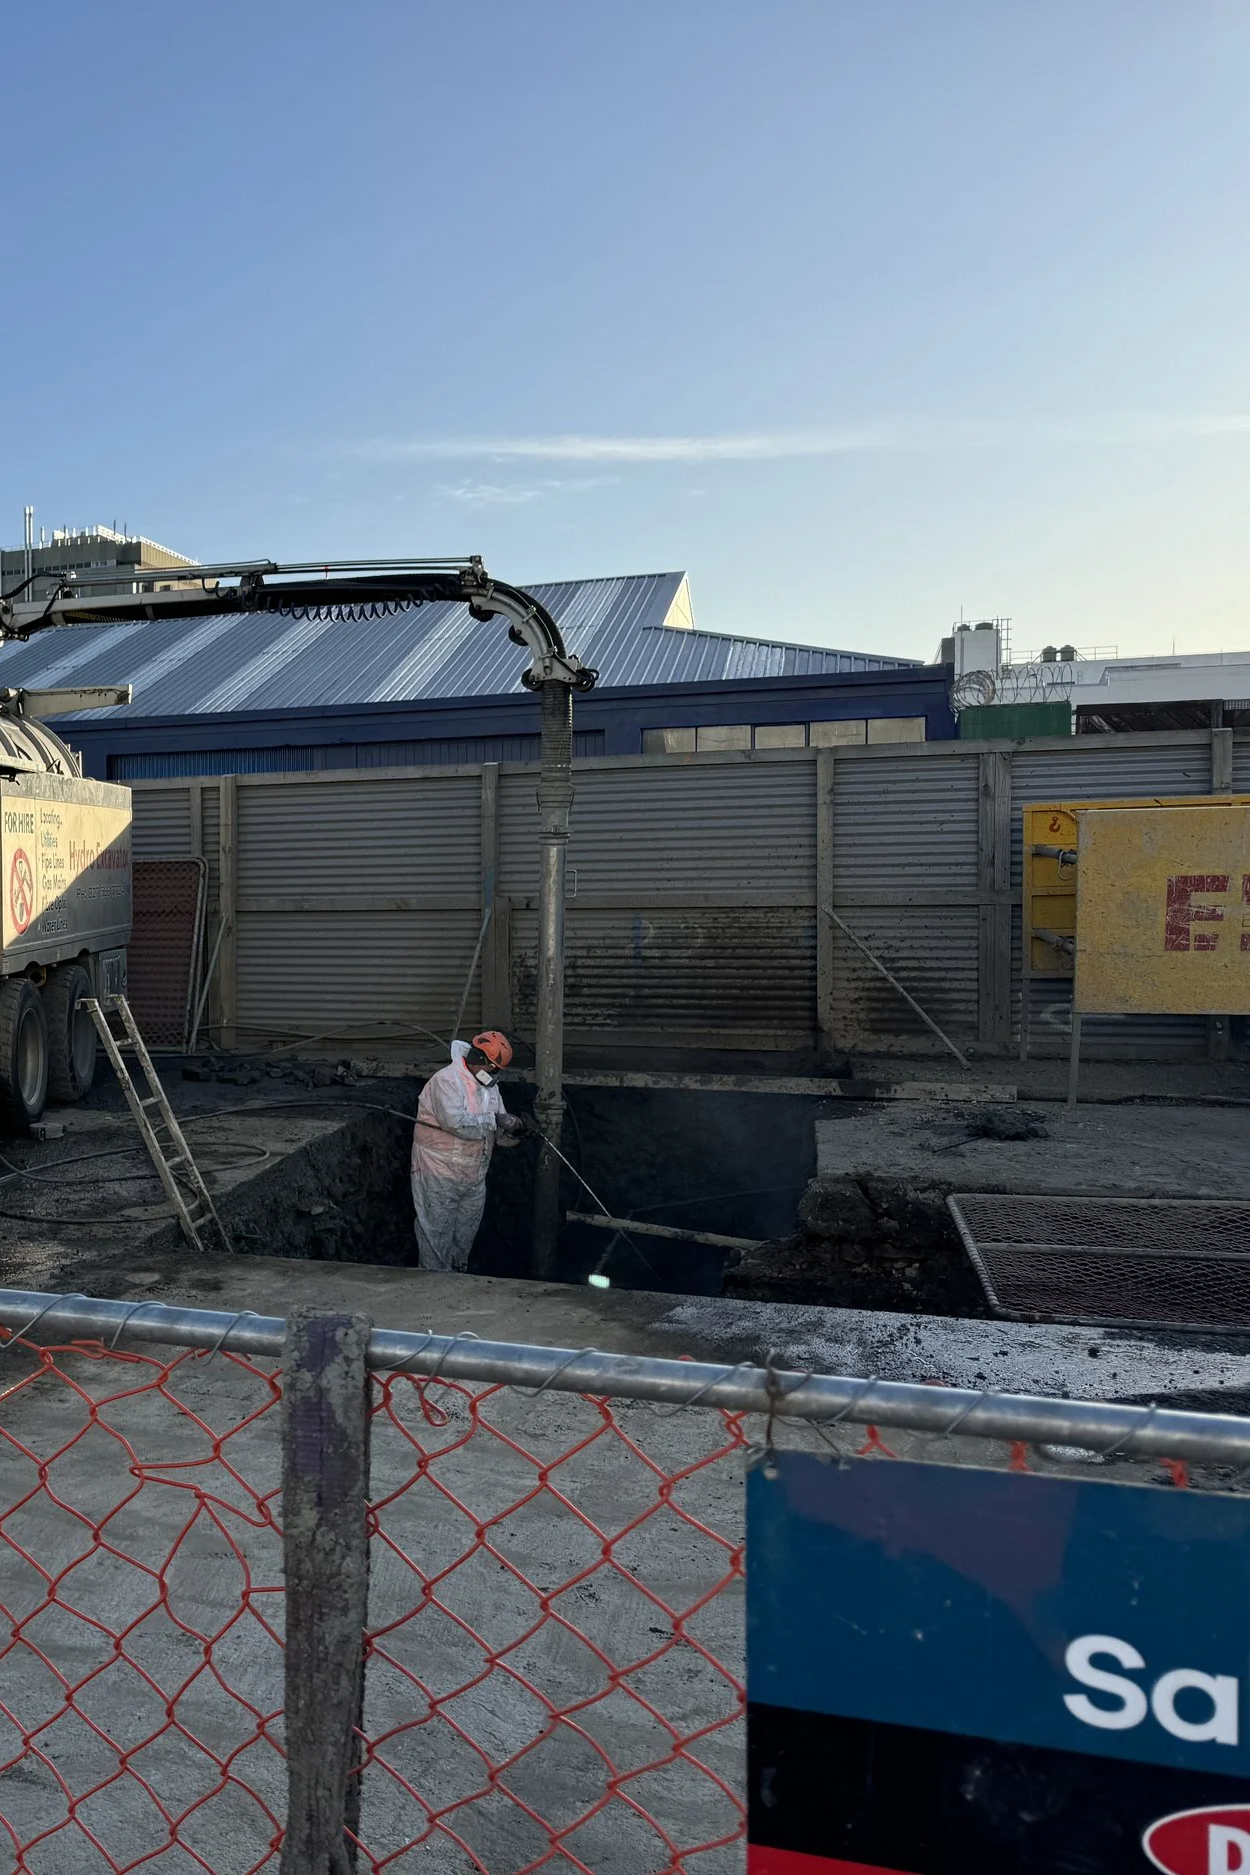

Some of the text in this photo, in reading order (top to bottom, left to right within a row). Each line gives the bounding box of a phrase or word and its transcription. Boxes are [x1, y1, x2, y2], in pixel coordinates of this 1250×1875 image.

[4, 811, 34, 834] FOR HIRE
[69, 840, 95, 877] Hydro
[1165, 874, 1250, 952] E
